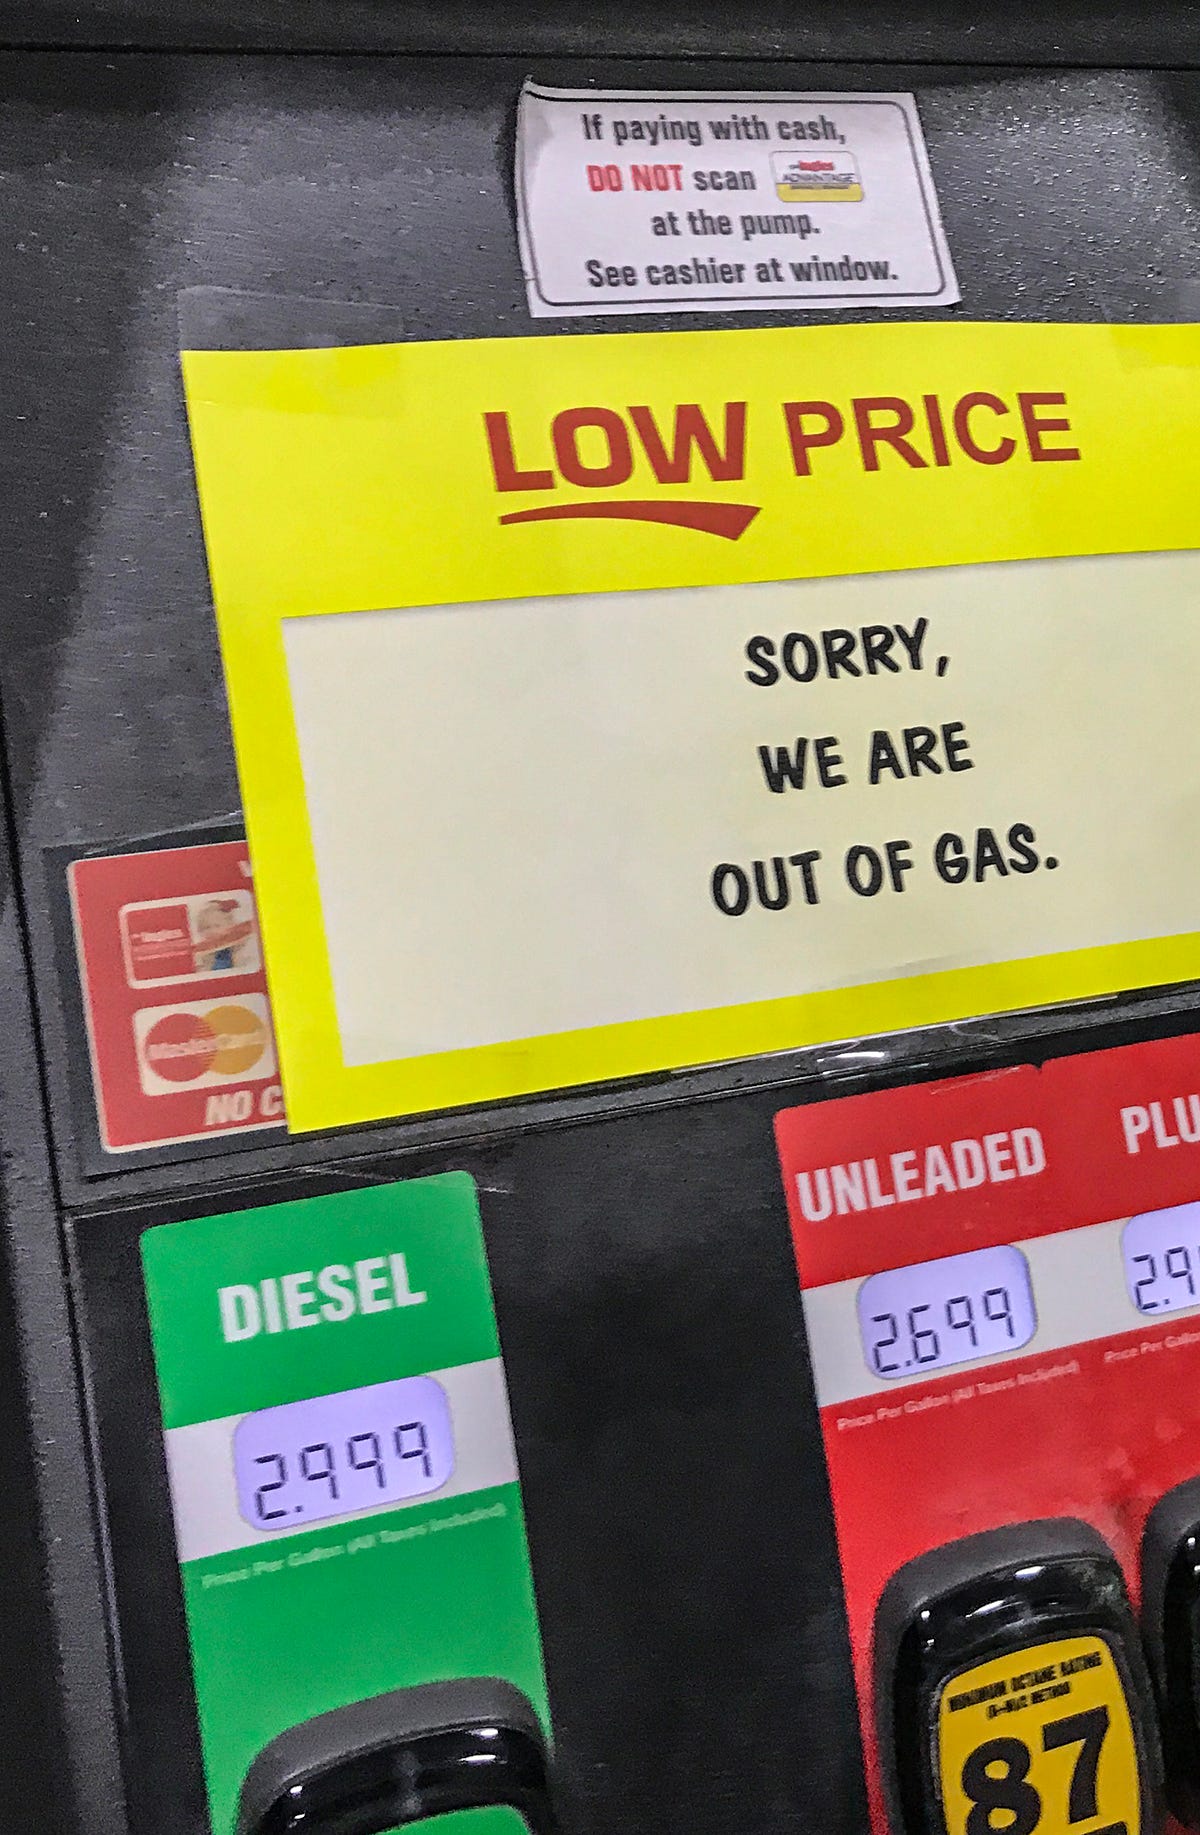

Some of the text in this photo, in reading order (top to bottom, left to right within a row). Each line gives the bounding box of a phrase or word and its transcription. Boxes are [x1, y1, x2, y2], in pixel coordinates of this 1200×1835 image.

[581, 113, 846, 146] If paying with cash,
[586, 164, 757, 192] DO NOT scan
[651, 210, 820, 241] at the pump.
[585, 254, 899, 288] See cashier at window.
[484, 391, 1081, 492] LOW PRICE
[745, 617, 948, 686] SORRY,
[757, 721, 974, 793] WE ARE
[711, 822, 1059, 916] OUT OF GAS.
[205, 1089, 254, 1126] NO
[796, 1126, 1047, 1222] UNLEADED
[217, 1252, 428, 1343] DIESEL
[870, 1286, 1016, 1373] 2.699
[253, 1421, 433, 1521] 2.999
[961, 1705, 1110, 1835] 87
